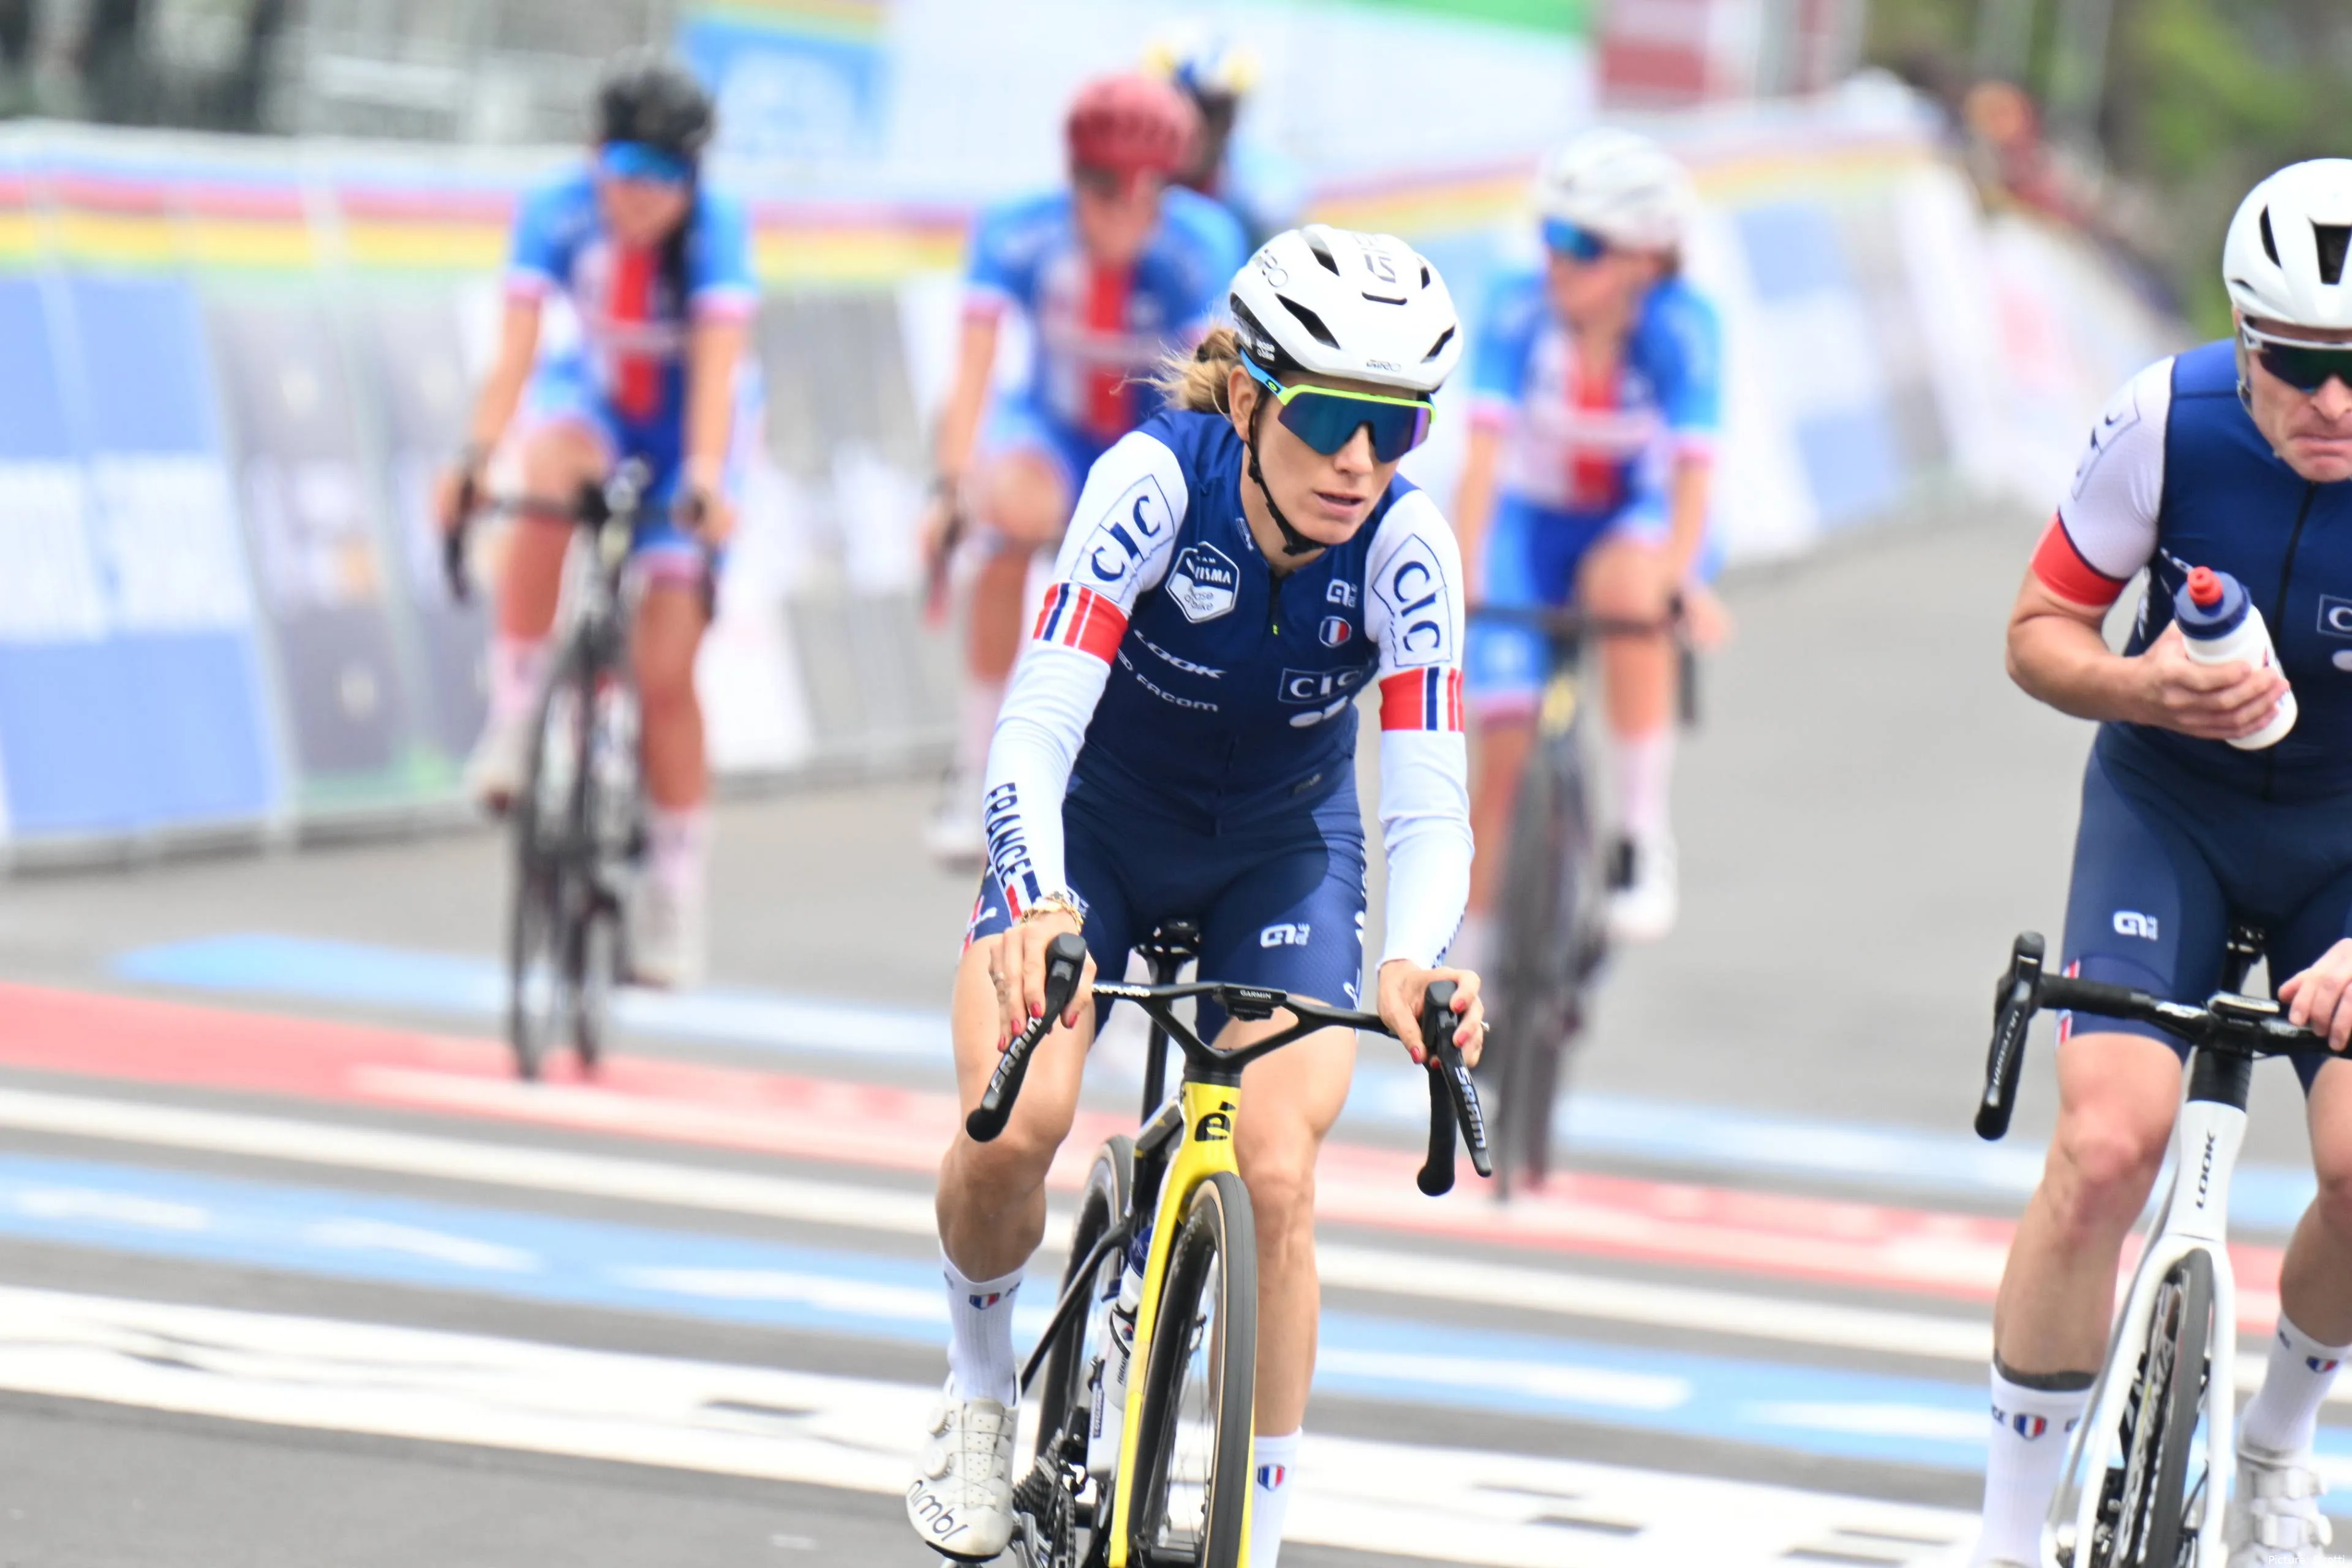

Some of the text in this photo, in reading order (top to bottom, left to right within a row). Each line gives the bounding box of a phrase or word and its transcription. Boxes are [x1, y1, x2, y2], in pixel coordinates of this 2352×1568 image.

[1091, 496, 1161, 582] CIC
[1185, 557, 1231, 585] VISMA
[1393, 560, 1440, 652] CIC
[1134, 629, 1227, 679] LOOK
[1289, 669, 1360, 698] CIC
[984, 782, 1032, 889] FRANCE
[1240, 989, 1272, 1000] GARMIN
[990, 1016, 1042, 1093] SRAM
[1455, 1066, 1487, 1149] SRAM
[2196, 1128, 2216, 1210] LOOK
[907, 1479, 969, 1542] nimbl
